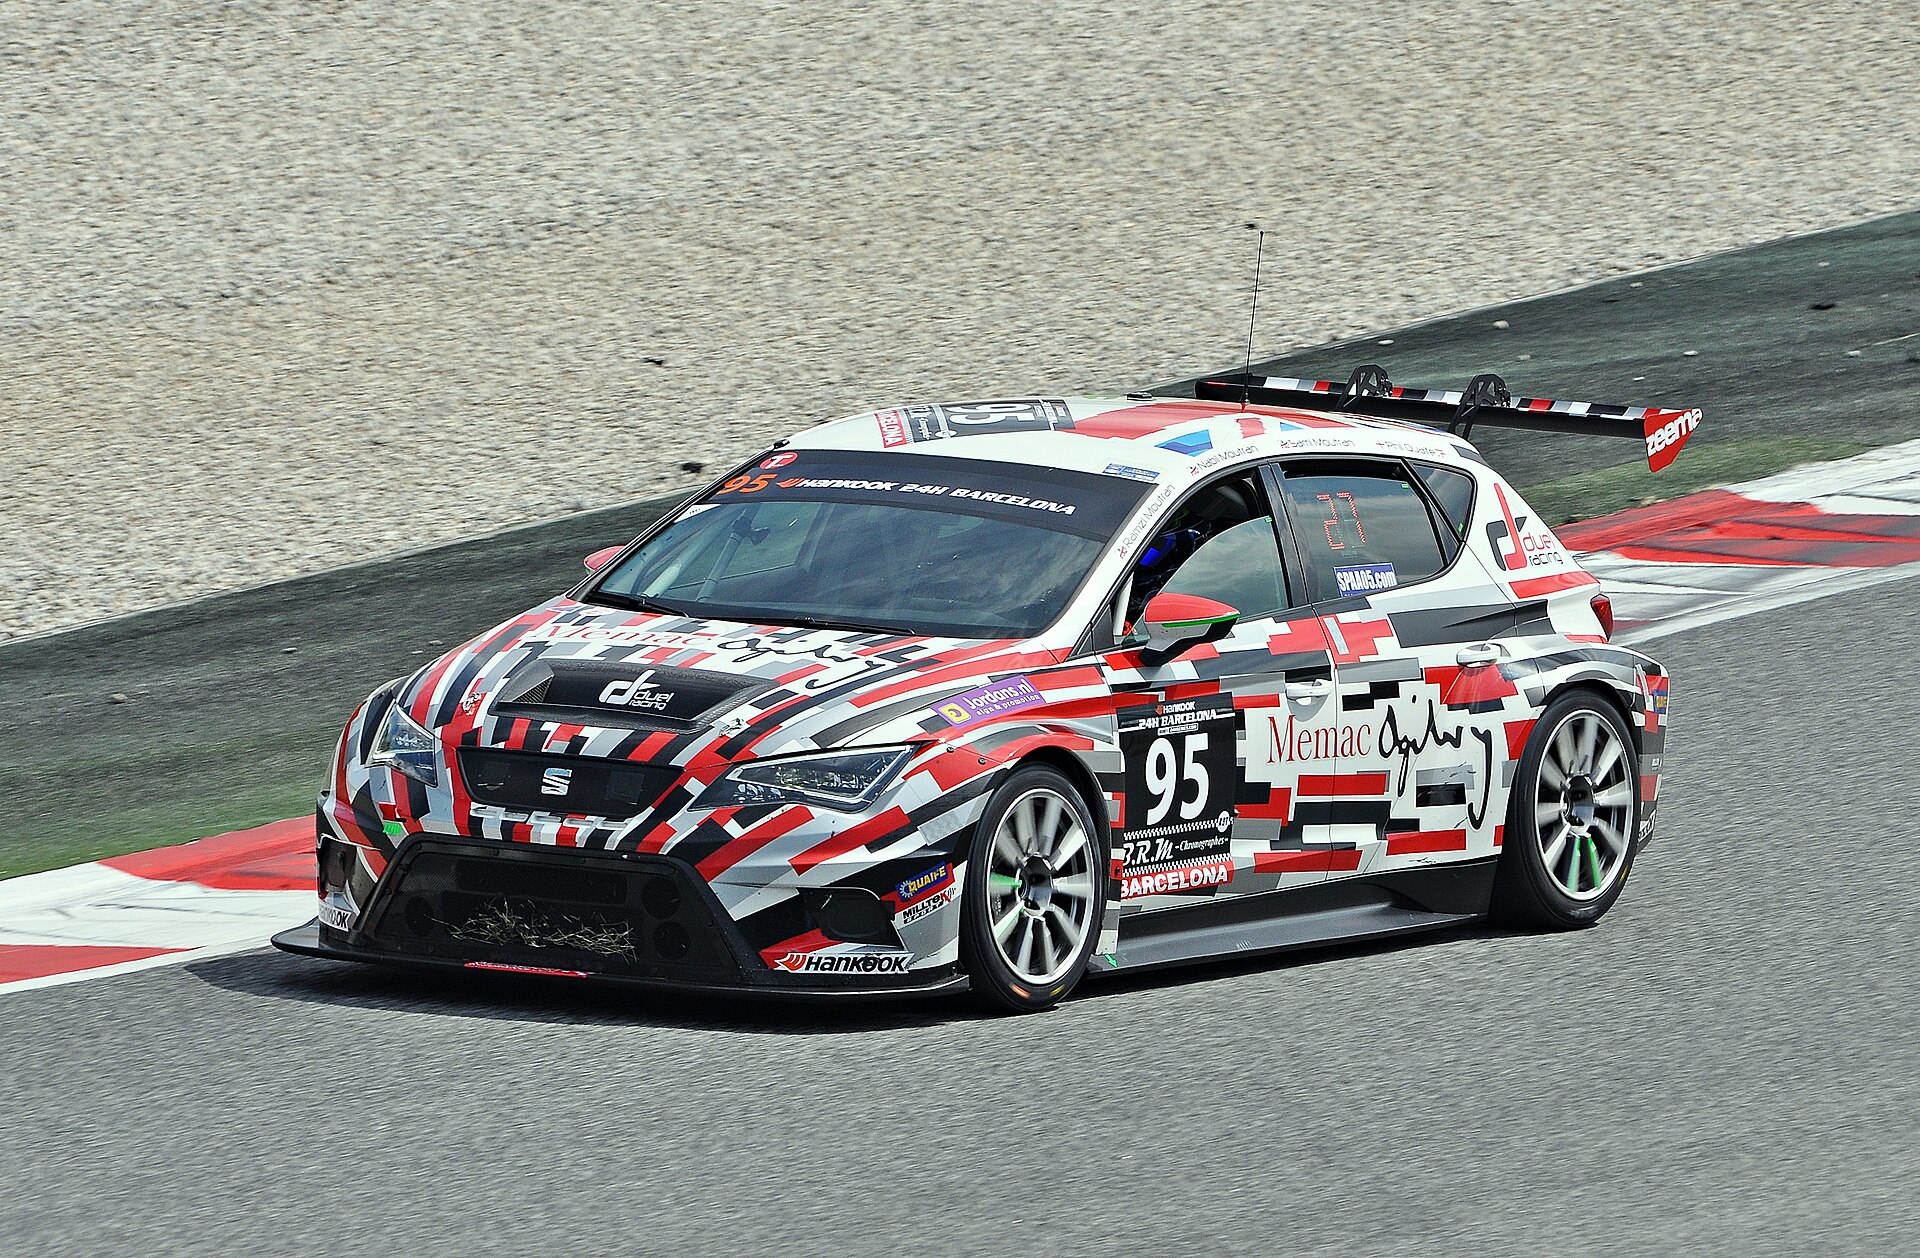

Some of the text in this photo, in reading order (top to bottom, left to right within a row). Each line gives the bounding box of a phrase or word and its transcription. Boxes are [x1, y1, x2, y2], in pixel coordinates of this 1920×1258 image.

[1646, 408, 1703, 457] zeema
[716, 473, 778, 495] 95
[899, 483, 950, 496] 24H
[948, 487, 1076, 517] BARCELONA
[1125, 484, 1176, 548] Ramzi Moutran
[1316, 491, 1367, 550] 27
[1522, 531, 1556, 552] duel
[1528, 551, 1564, 567] racing
[532, 624, 712, 645] Memac
[628, 699, 667, 711] racing
[633, 689, 675, 703] duel
[962, 678, 1035, 710] Jordans.nl
[1002, 694, 1040, 710] promotion
[1138, 709, 1217, 729] 24H BARCELONA
[1266, 694, 1494, 830] Memac Ogilvy
[1145, 732, 1210, 826] 95
[907, 865, 947, 892] QUAIFE
[1121, 864, 1228, 898] BARCELONA
